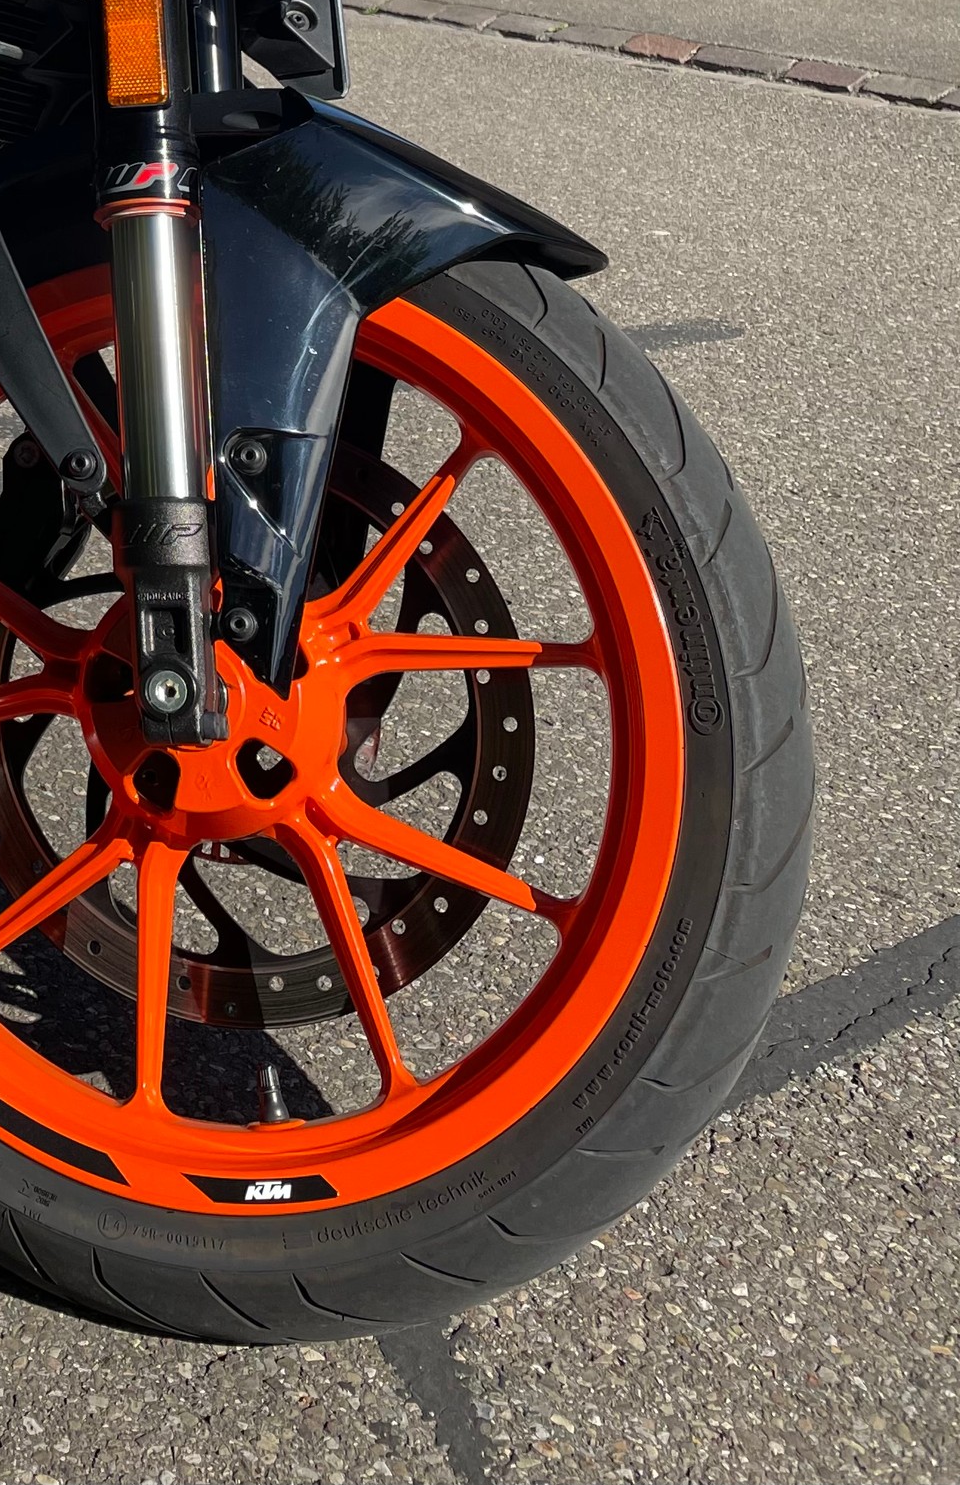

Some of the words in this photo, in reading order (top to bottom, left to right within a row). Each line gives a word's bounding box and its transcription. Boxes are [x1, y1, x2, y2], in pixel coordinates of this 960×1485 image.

[481, 308, 508, 331] COLD
[548, 384, 576, 411] LOAD
[572, 917, 694, 1110] www.conti-moto.com
[244, 1180, 292, 1201] KTM
[496, 1170, 518, 1187] 1871
[316, 1207, 413, 1245] deutsche
[417, 1170, 492, 1215] technik
